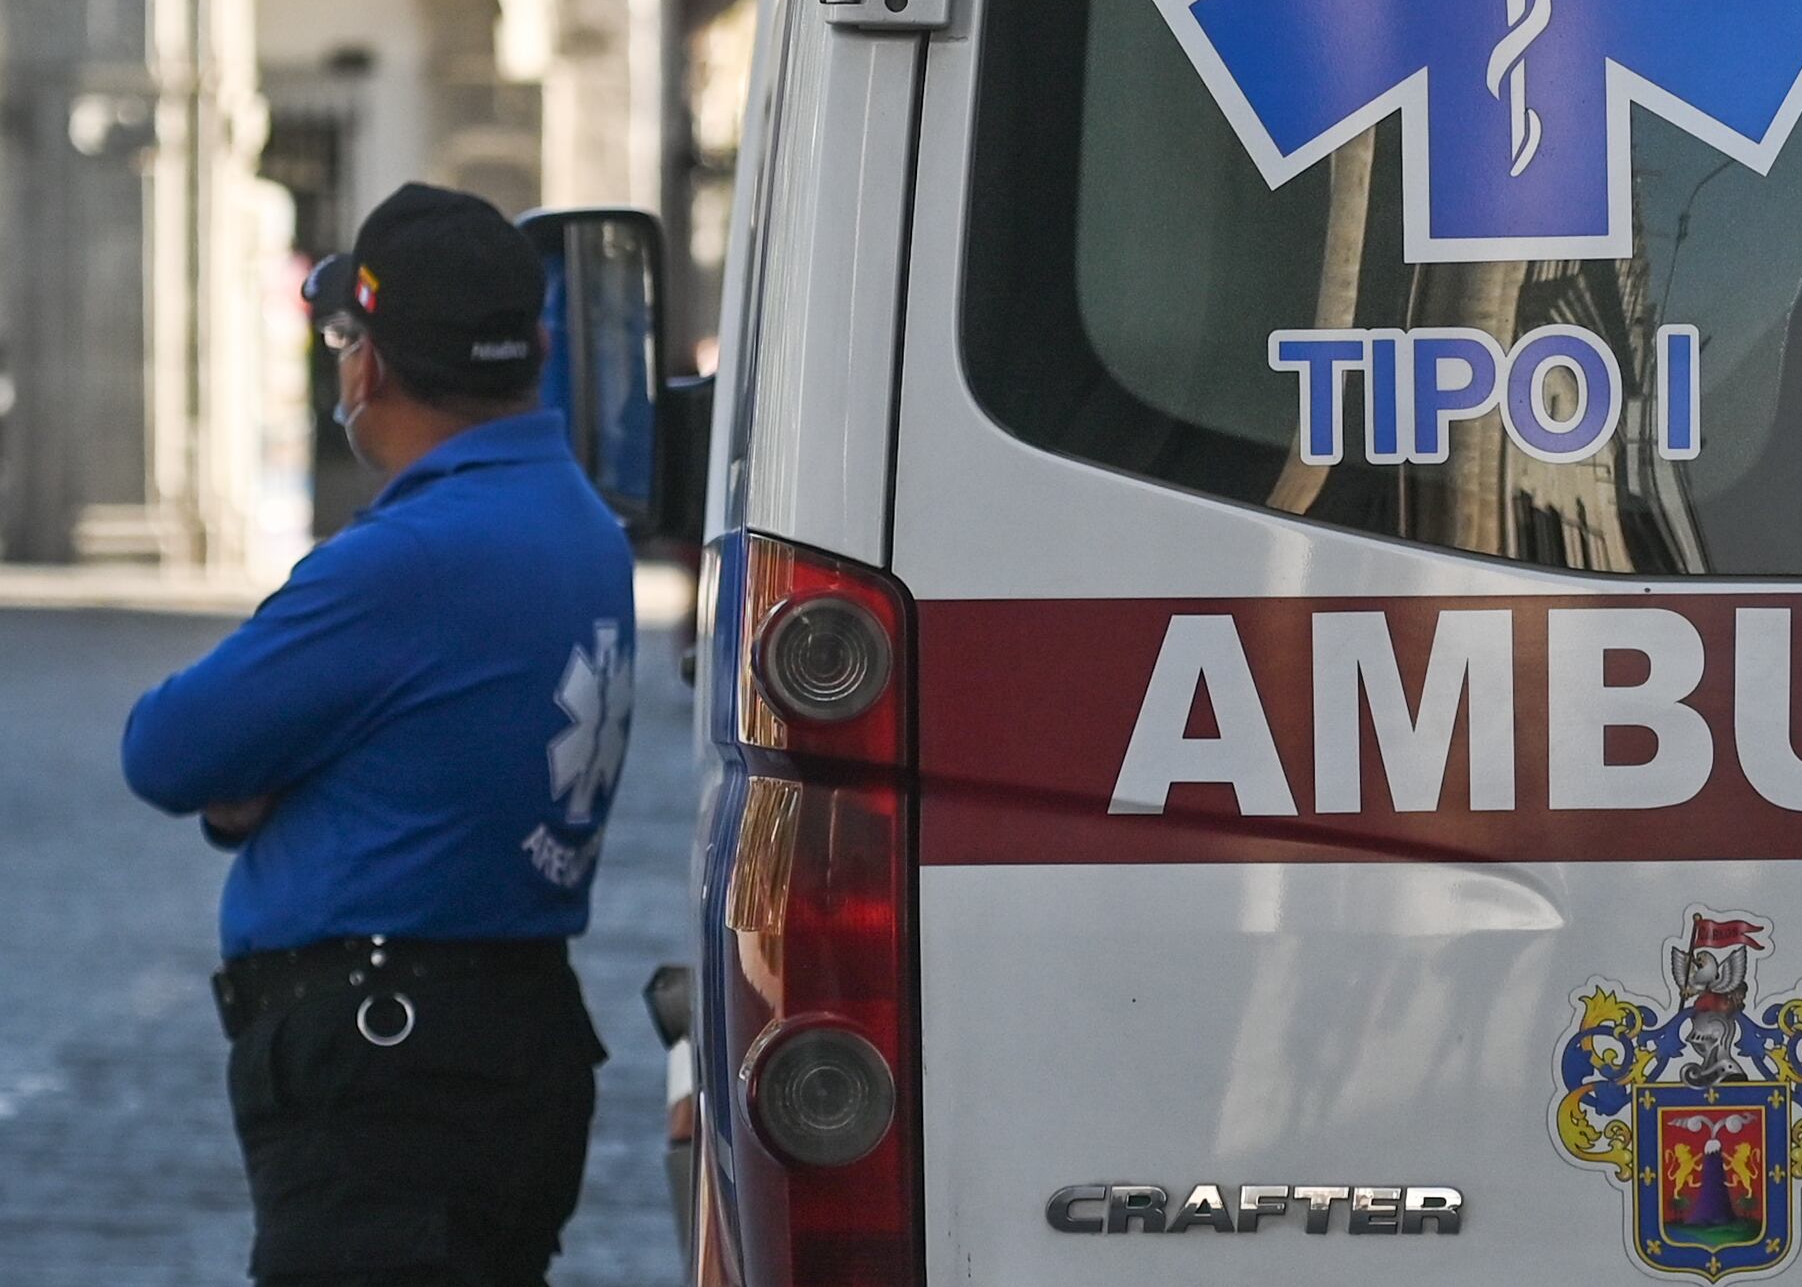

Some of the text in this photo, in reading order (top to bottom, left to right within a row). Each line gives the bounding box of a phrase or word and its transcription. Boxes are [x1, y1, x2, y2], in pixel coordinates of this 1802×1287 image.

[1268, 323, 1701, 465] TIPO I
[1045, 1184, 1464, 1235] CRAFTER
